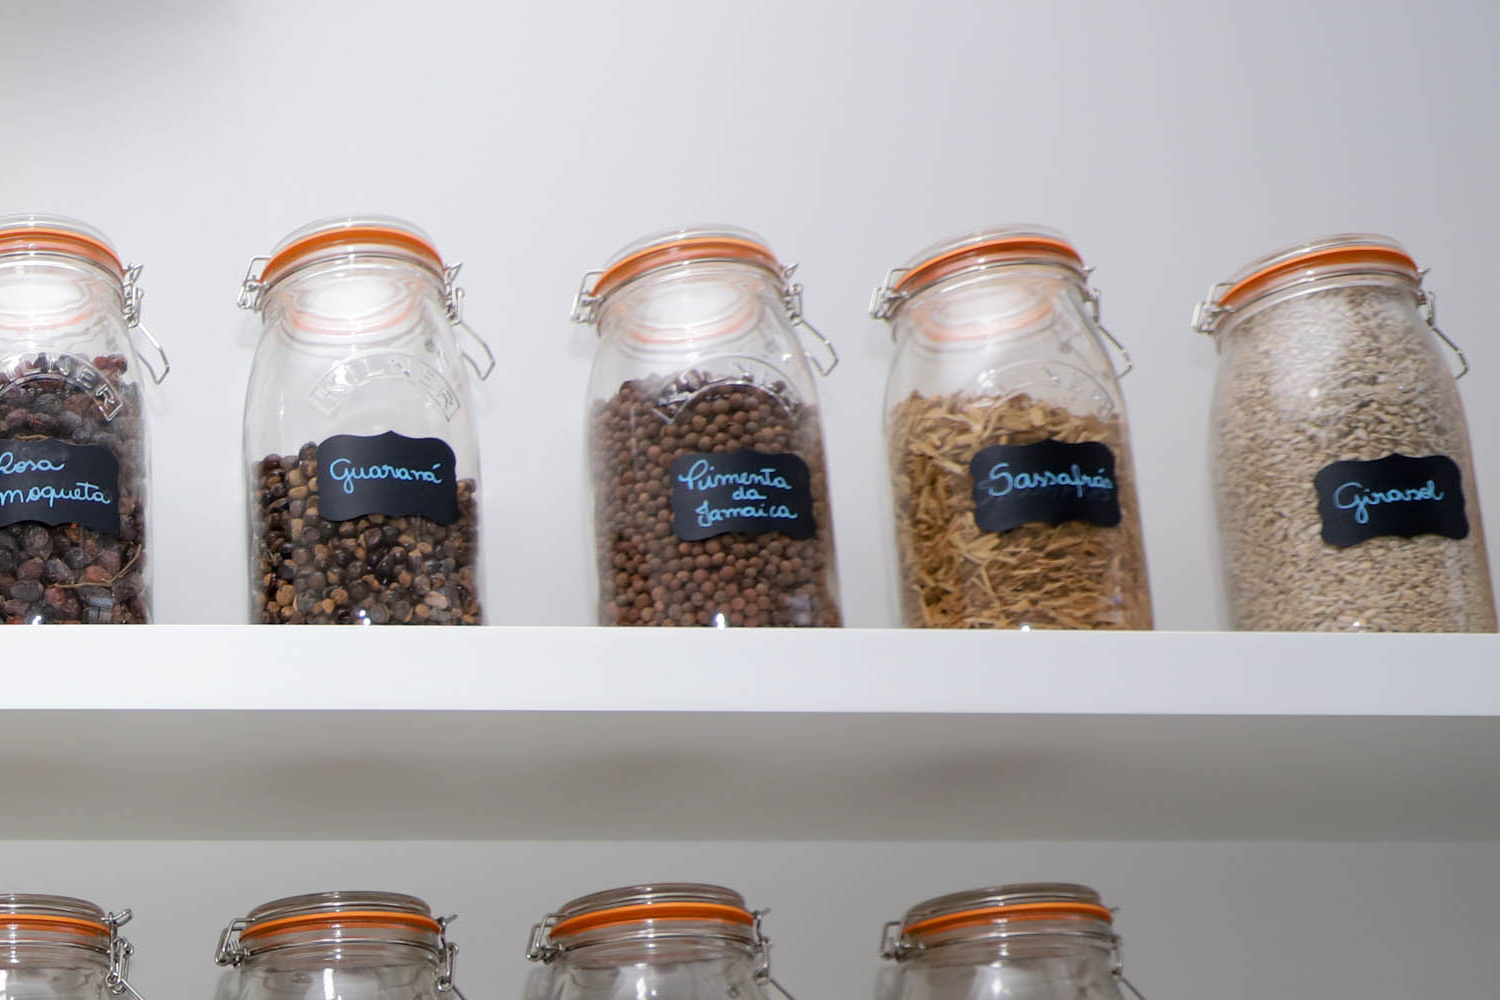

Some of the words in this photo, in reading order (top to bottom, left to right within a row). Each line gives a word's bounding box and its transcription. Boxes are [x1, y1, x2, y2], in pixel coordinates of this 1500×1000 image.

[329, 458, 443, 494] Guaraná
[678, 459, 792, 490] Pimenta
[988, 462, 1113, 498] Sassafrás
[695, 500, 798, 527] Jamaica
[1334, 479, 1444, 524] Girasol
